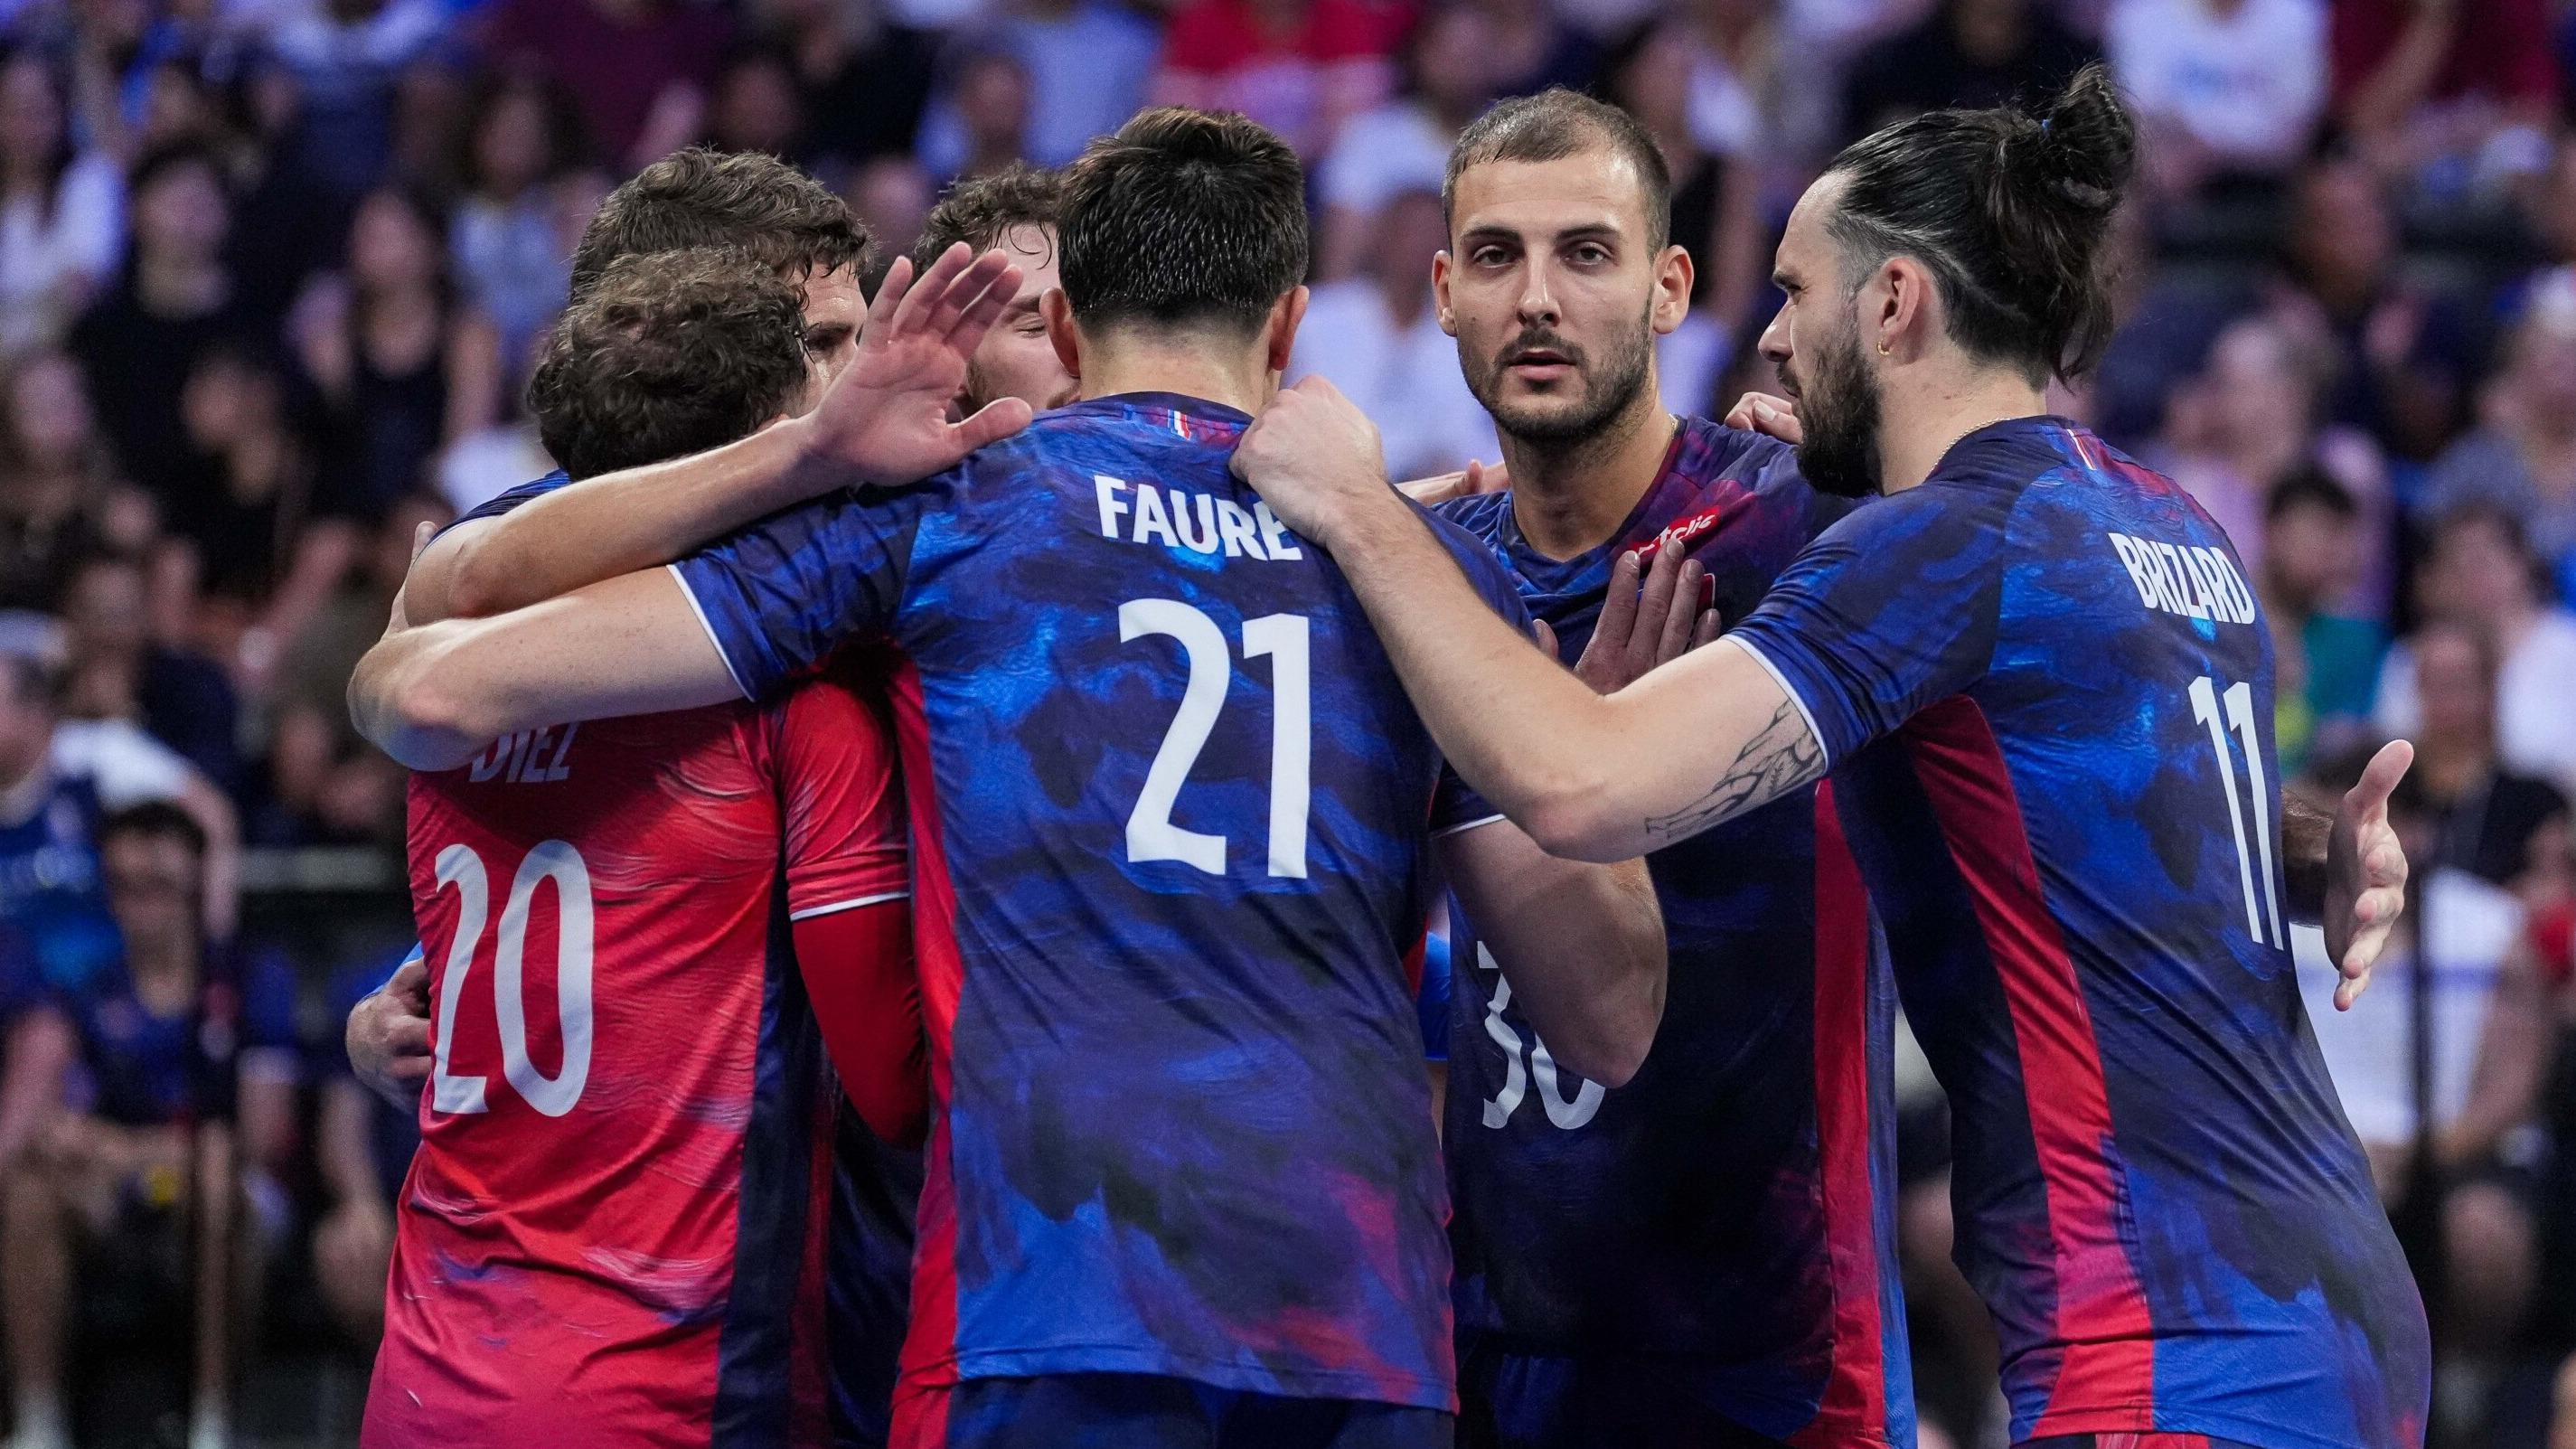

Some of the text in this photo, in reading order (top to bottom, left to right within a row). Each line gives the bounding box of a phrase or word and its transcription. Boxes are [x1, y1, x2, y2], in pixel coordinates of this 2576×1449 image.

[1094, 475, 1302, 561] FAURE
[2108, 532, 2256, 625] BRIZARD
[1117, 597, 1311, 880] 21
[2187, 675, 2284, 951] 11
[432, 839, 594, 1117] 20
